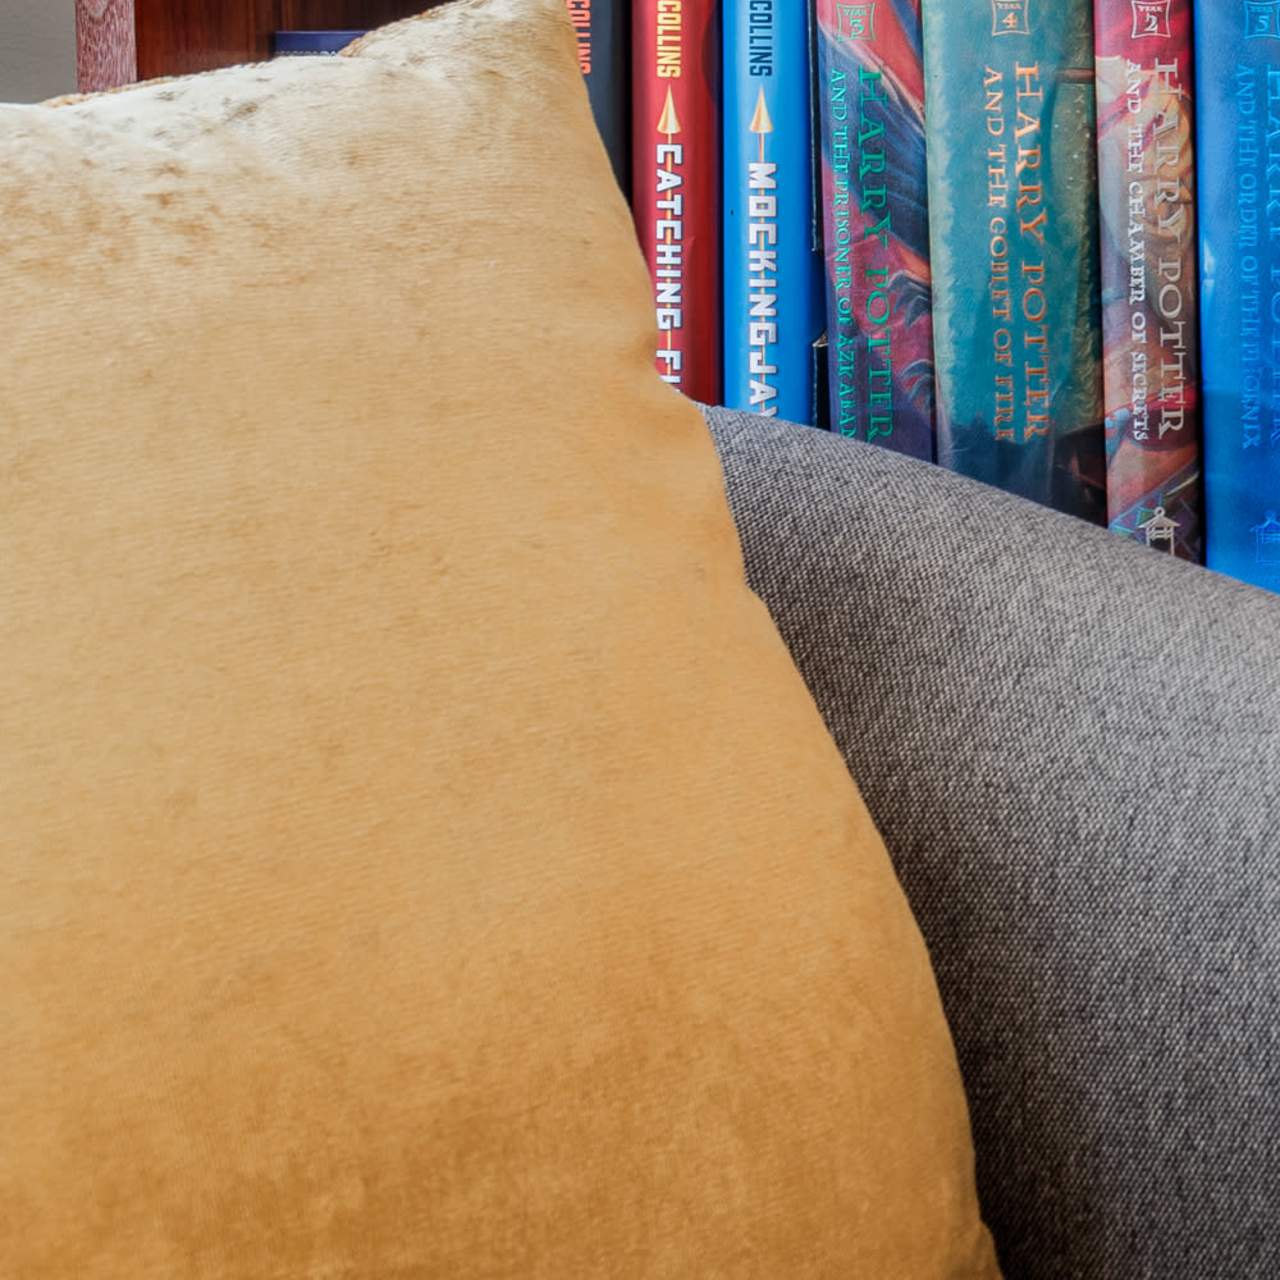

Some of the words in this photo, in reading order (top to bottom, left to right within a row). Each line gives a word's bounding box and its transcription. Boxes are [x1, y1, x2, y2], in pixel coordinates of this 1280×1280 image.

[657, 0, 682, 78] COLLINS
[749, 0, 773, 77] COLLINS
[1003, 12, 1017, 30] 4
[1144, 13, 1158, 34] 2
[1257, 15, 1270, 32] 5
[830, 69, 847, 122] AND
[983, 67, 1005, 136] AND
[1126, 59, 1142, 114] AND
[1236, 64, 1254, 117] AND
[831, 126, 851, 175] THE
[858, 68, 892, 249] HARRY
[986, 145, 1009, 207] THE
[1014, 61, 1047, 244] HARRY
[1127, 124, 1144, 172] THE
[1152, 58, 1182, 236] HARRY
[1237, 120, 1259, 168] THE
[656, 143, 683, 330] CATCHING
[832, 179, 852, 291] PRISONER
[1128, 181, 1147, 305] CHAMBER
[1237, 173, 1259, 249] ORDER
[989, 217, 1011, 318] GOBLET
[1239, 256, 1259, 286] OF
[837, 296, 852, 324] OF
[1130, 313, 1148, 345] OF
[1240, 289, 1261, 338] THE
[864, 267, 895, 443] POTTER
[992, 328, 1012, 367] OF
[1021, 261, 1051, 443] POTTER
[1158, 258, 1186, 440] POTTER
[837, 335, 856, 439] AZKABAN
[995, 373, 1014, 442] FIRE
[1131, 351, 1150, 441] SECRETS
